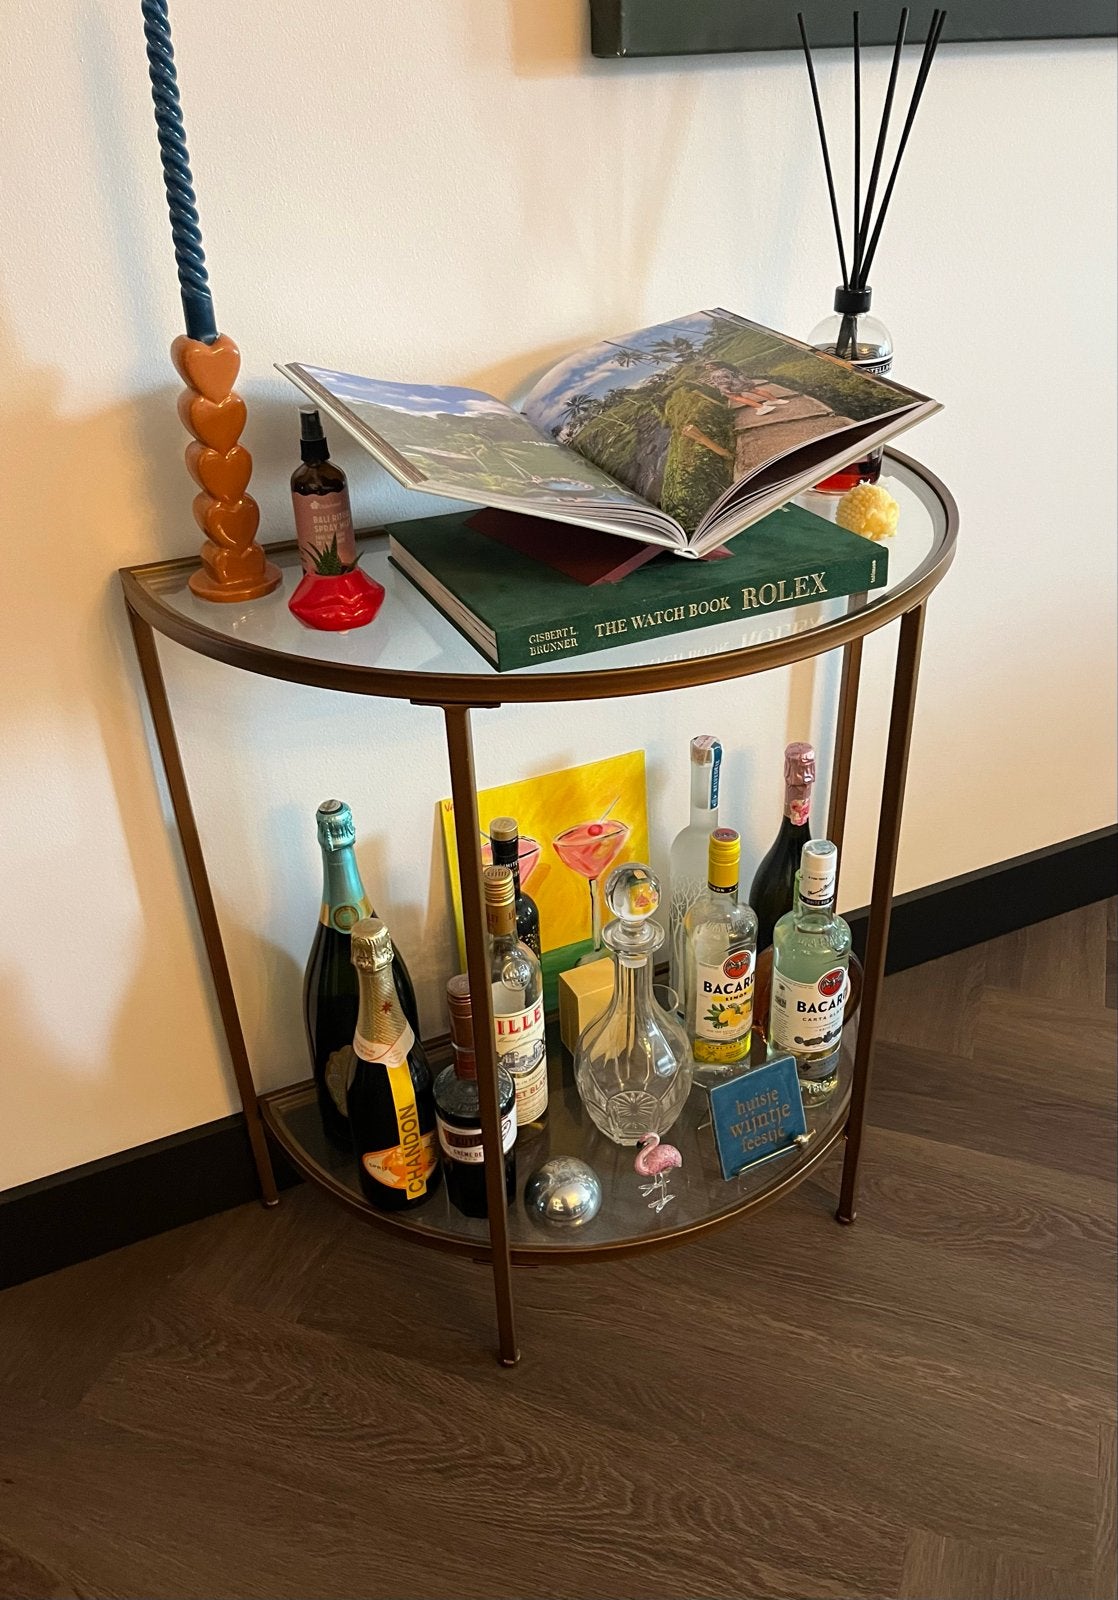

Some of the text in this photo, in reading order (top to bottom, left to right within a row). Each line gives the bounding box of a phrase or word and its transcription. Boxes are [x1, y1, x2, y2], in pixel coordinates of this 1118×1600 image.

[312, 515, 330, 524] BALI
[314, 524, 338, 533] SPRAY
[741, 571, 828, 611] ROLEX
[594, 596, 731, 638] THE WATCH BOOK
[528, 625, 580, 645] GISBERT L.
[529, 637, 579, 656] BRUNNER
[796, 992, 846, 1014] BACAR
[496, 1005, 542, 1036] ILLE
[735, 1088, 779, 1116] huisje
[729, 1101, 792, 1139] wijntje
[398, 1103, 425, 1193] CHANDON
